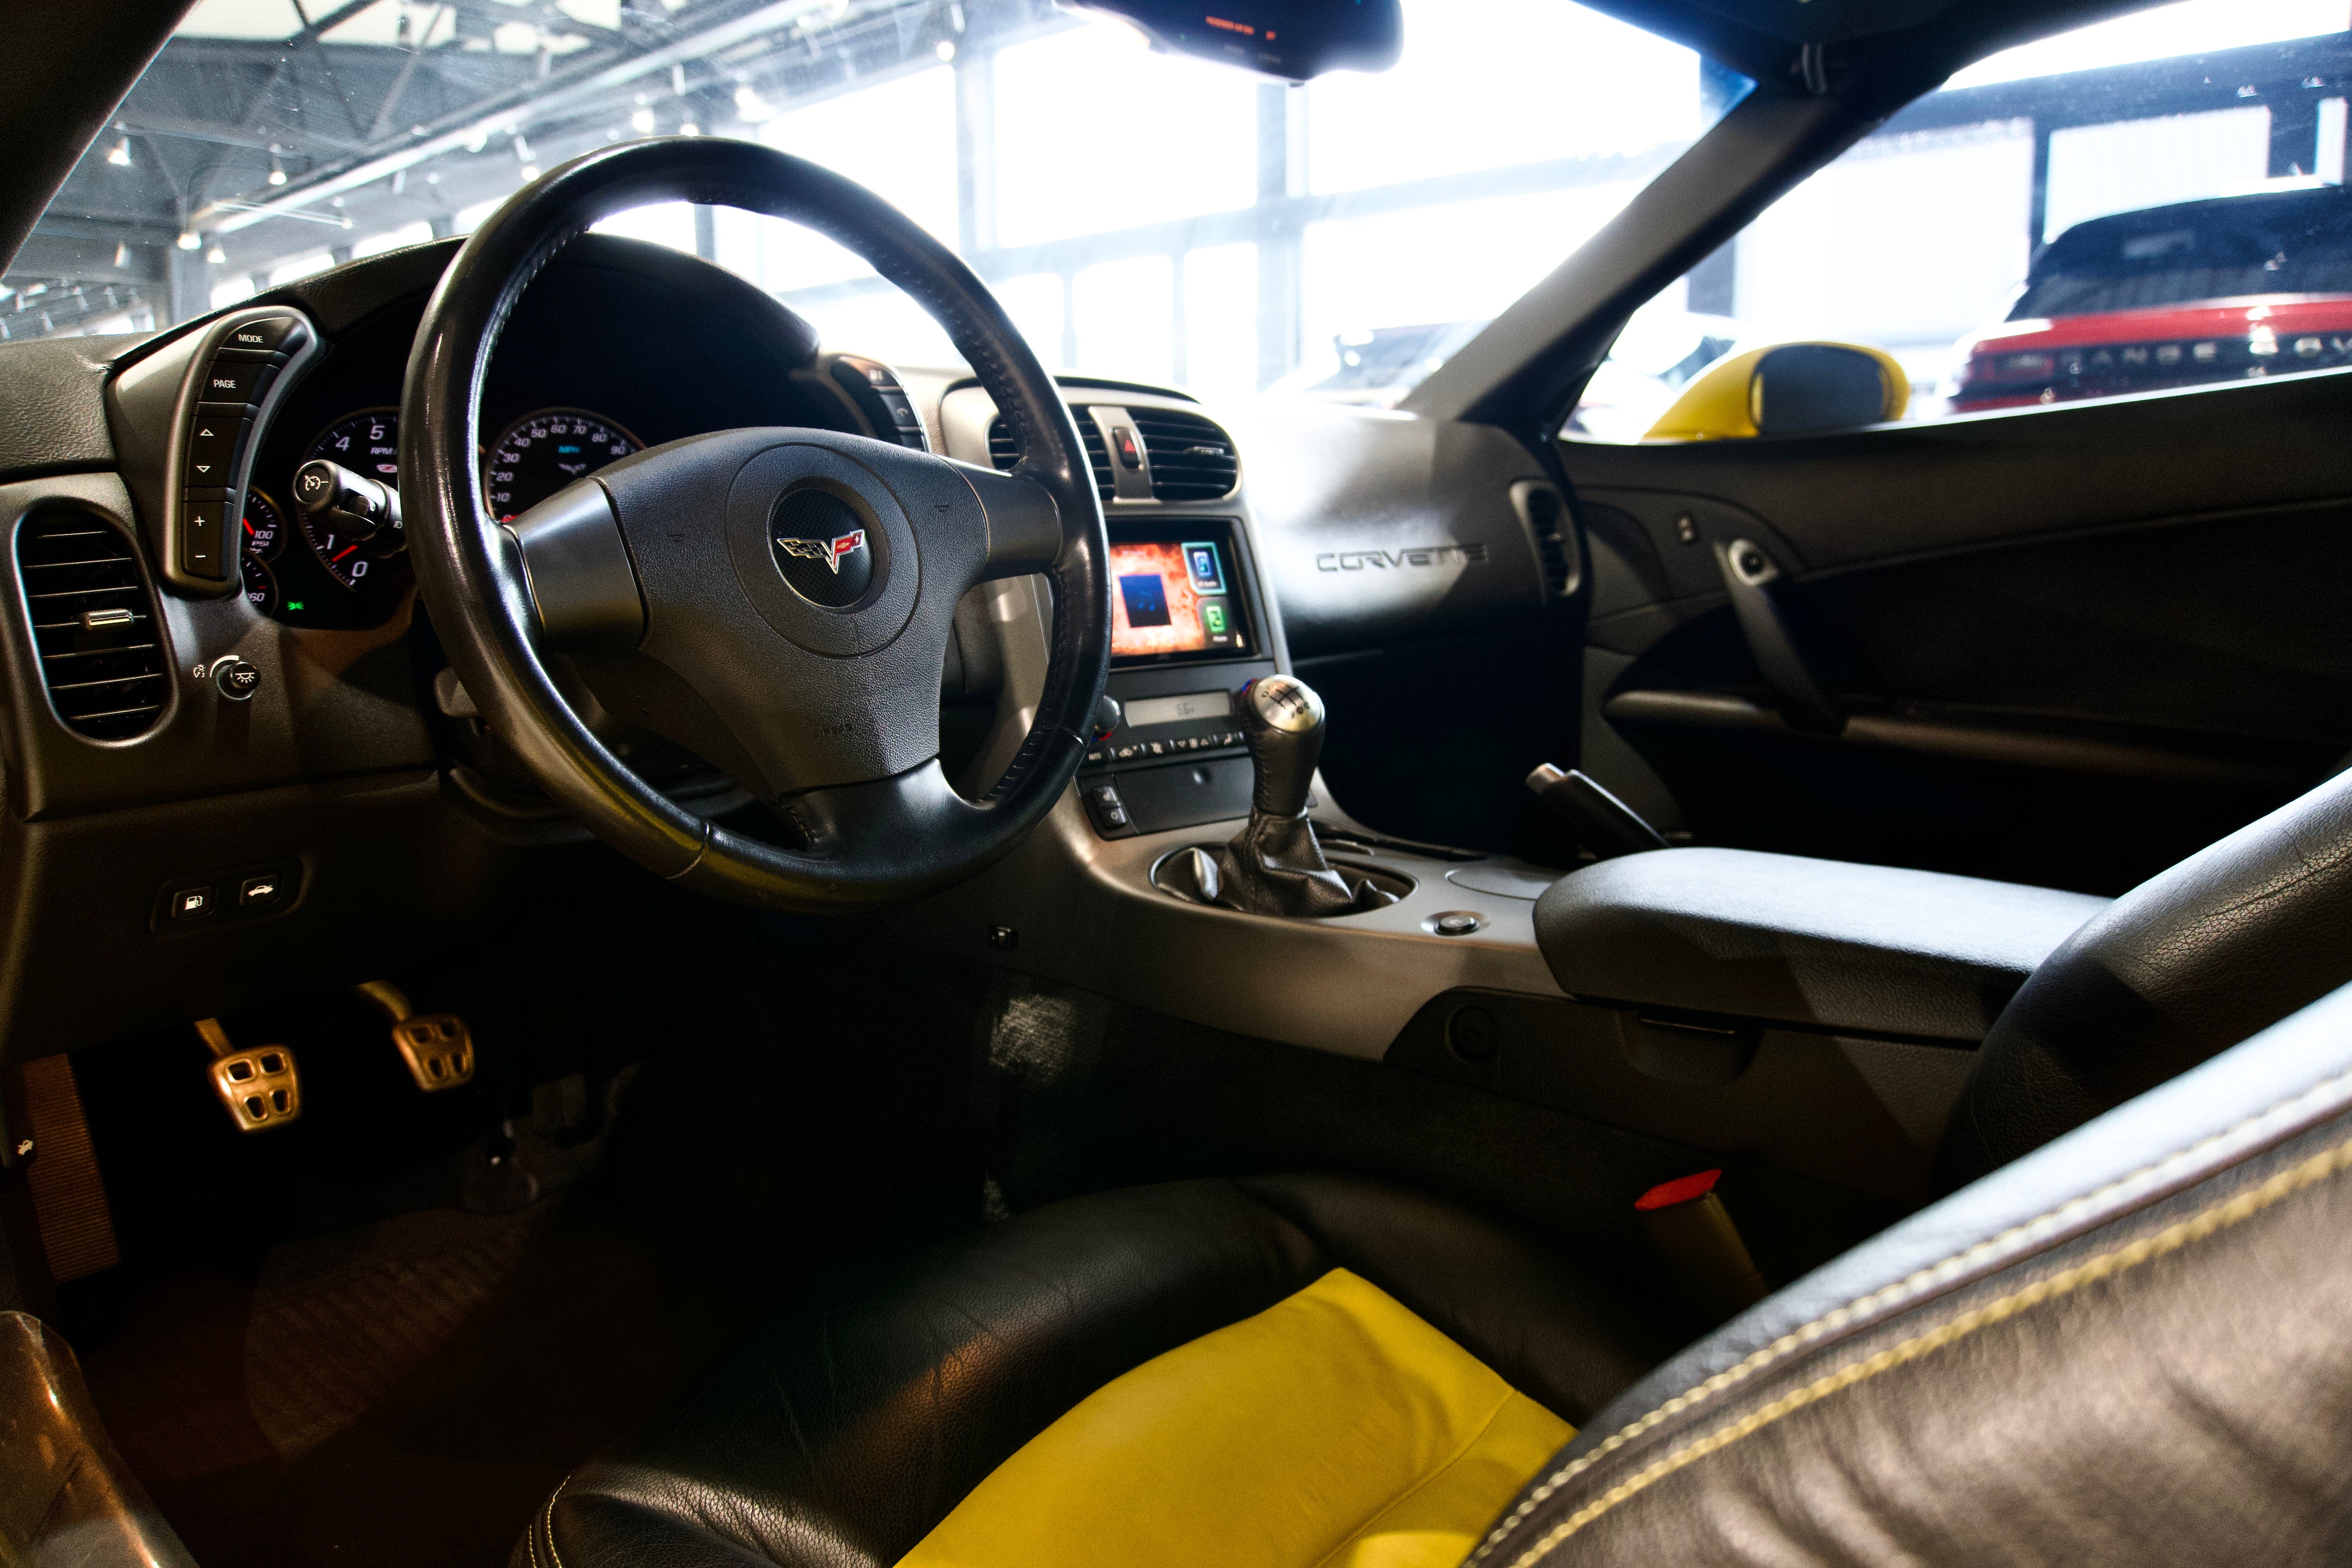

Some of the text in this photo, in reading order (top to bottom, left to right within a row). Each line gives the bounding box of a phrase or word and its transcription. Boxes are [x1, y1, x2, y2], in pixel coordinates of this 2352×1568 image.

[238, 334, 263, 343] MODE
[214, 379, 236, 389] PAGE
[370, 425, 385, 440] 5
[531, 429, 547, 439] 50
[550, 424, 567, 434] 60
[573, 425, 587, 434] 70
[514, 437, 531, 448] 40
[592, 433, 608, 443] 80
[335, 436, 350, 451] 4
[558, 445, 581, 454] MPH
[611, 445, 626, 455] 90
[503, 453, 520, 463] 30
[496, 472, 513, 482] 20
[497, 492, 510, 502] 10
[254, 530, 274, 539] 100
[326, 534, 334, 550] 1
[1316, 543, 1488, 571] CORVETTE
[352, 561, 368, 577] 0
[248, 592, 265, 601] 60
